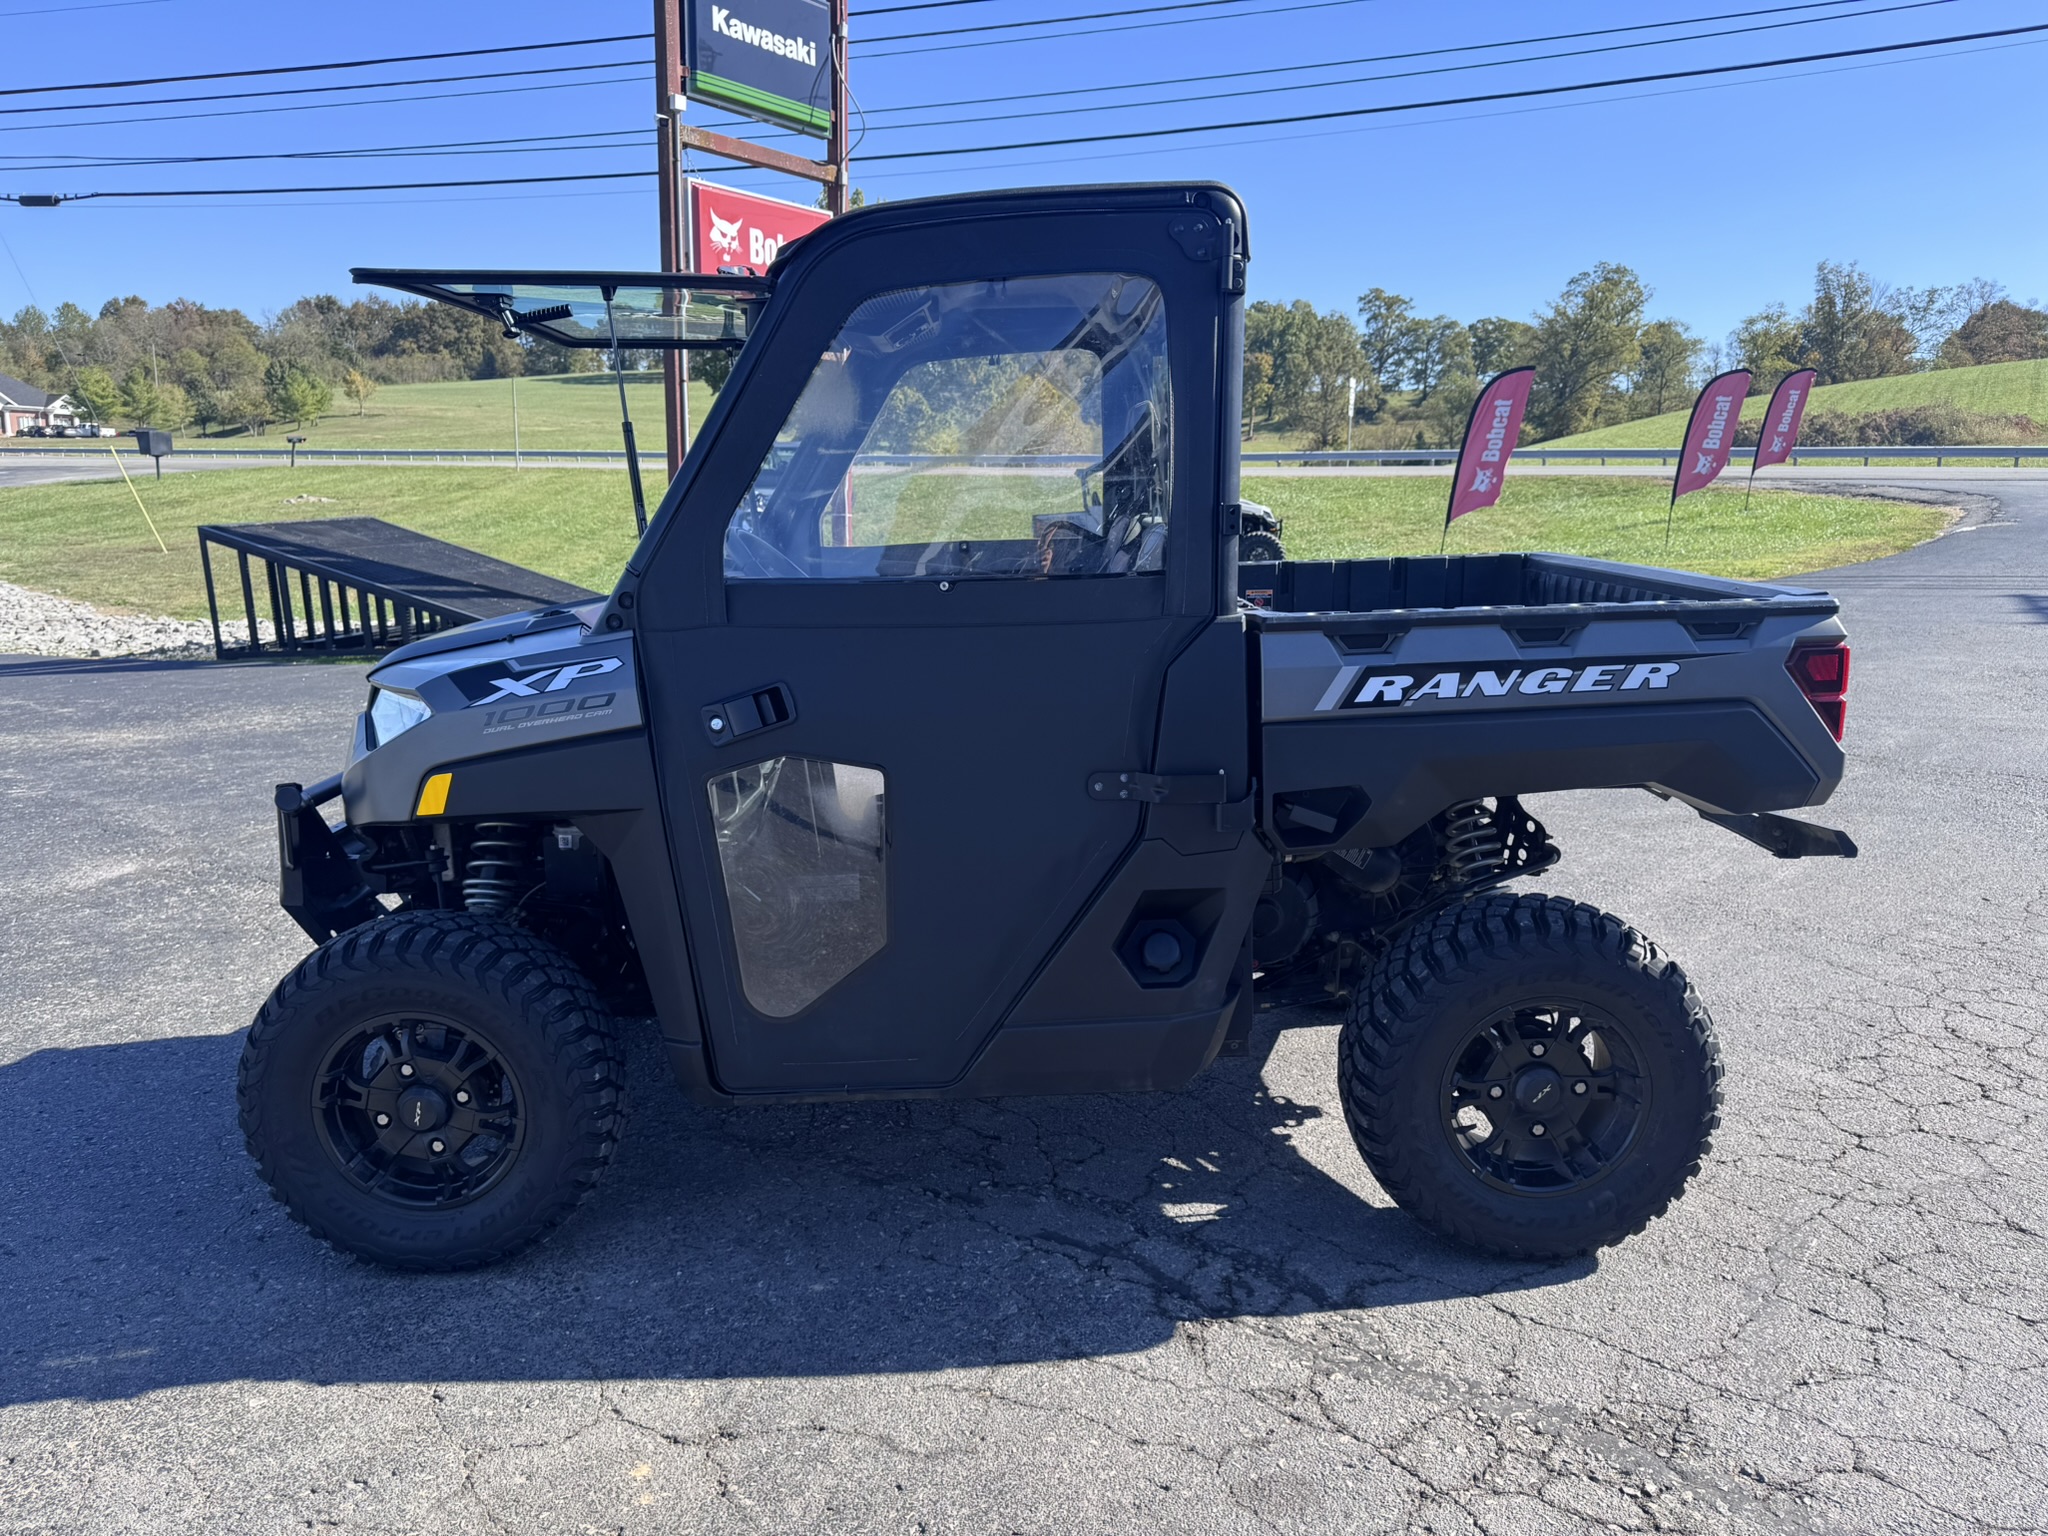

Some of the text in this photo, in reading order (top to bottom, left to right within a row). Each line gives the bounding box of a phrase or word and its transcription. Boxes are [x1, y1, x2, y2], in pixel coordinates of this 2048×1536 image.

[711, 4, 817, 67] Kawasaki
[1481, 399, 1513, 462] Bobcat
[1701, 395, 1733, 449] Bobcat
[1776, 389, 1801, 432] Bobcat
[470, 656, 625, 708] XP
[1353, 661, 1681, 703] RANGER
[482, 708, 614, 735] DUAL OVERHEAD CAM
[483, 692, 617, 726] 1000
